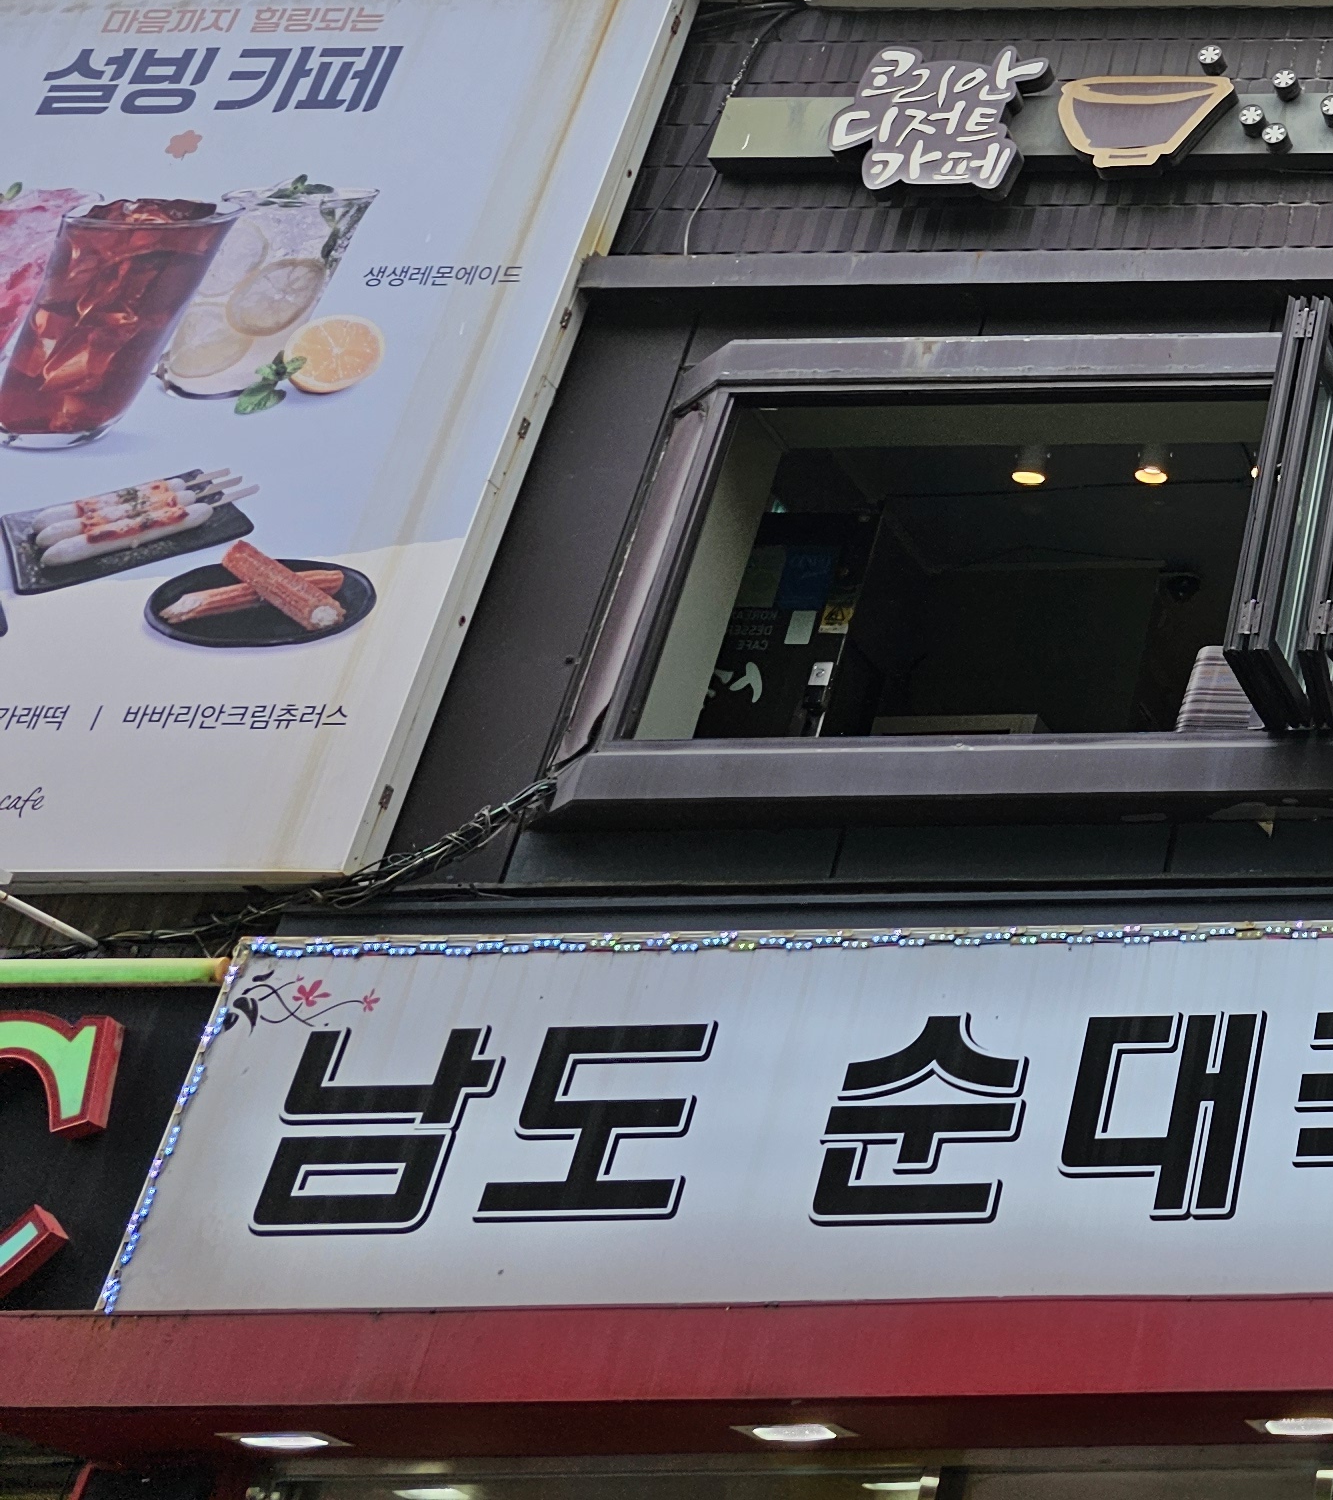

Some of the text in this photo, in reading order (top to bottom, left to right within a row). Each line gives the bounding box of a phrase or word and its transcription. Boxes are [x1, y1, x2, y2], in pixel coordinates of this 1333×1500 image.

[101, 7, 384, 34] 마음까지 힐링되는
[35, 46, 404, 115] 설빙 카페
[861, 50, 1044, 108] 코리안
[832, 100, 998, 147] 디저트
[870, 140, 1010, 184] 카페
[363, 265, 522, 287] 생생레몬에이드
[123, 704, 348, 730] 바바리안크림츄러스
[248, 1019, 720, 1234] 남도
